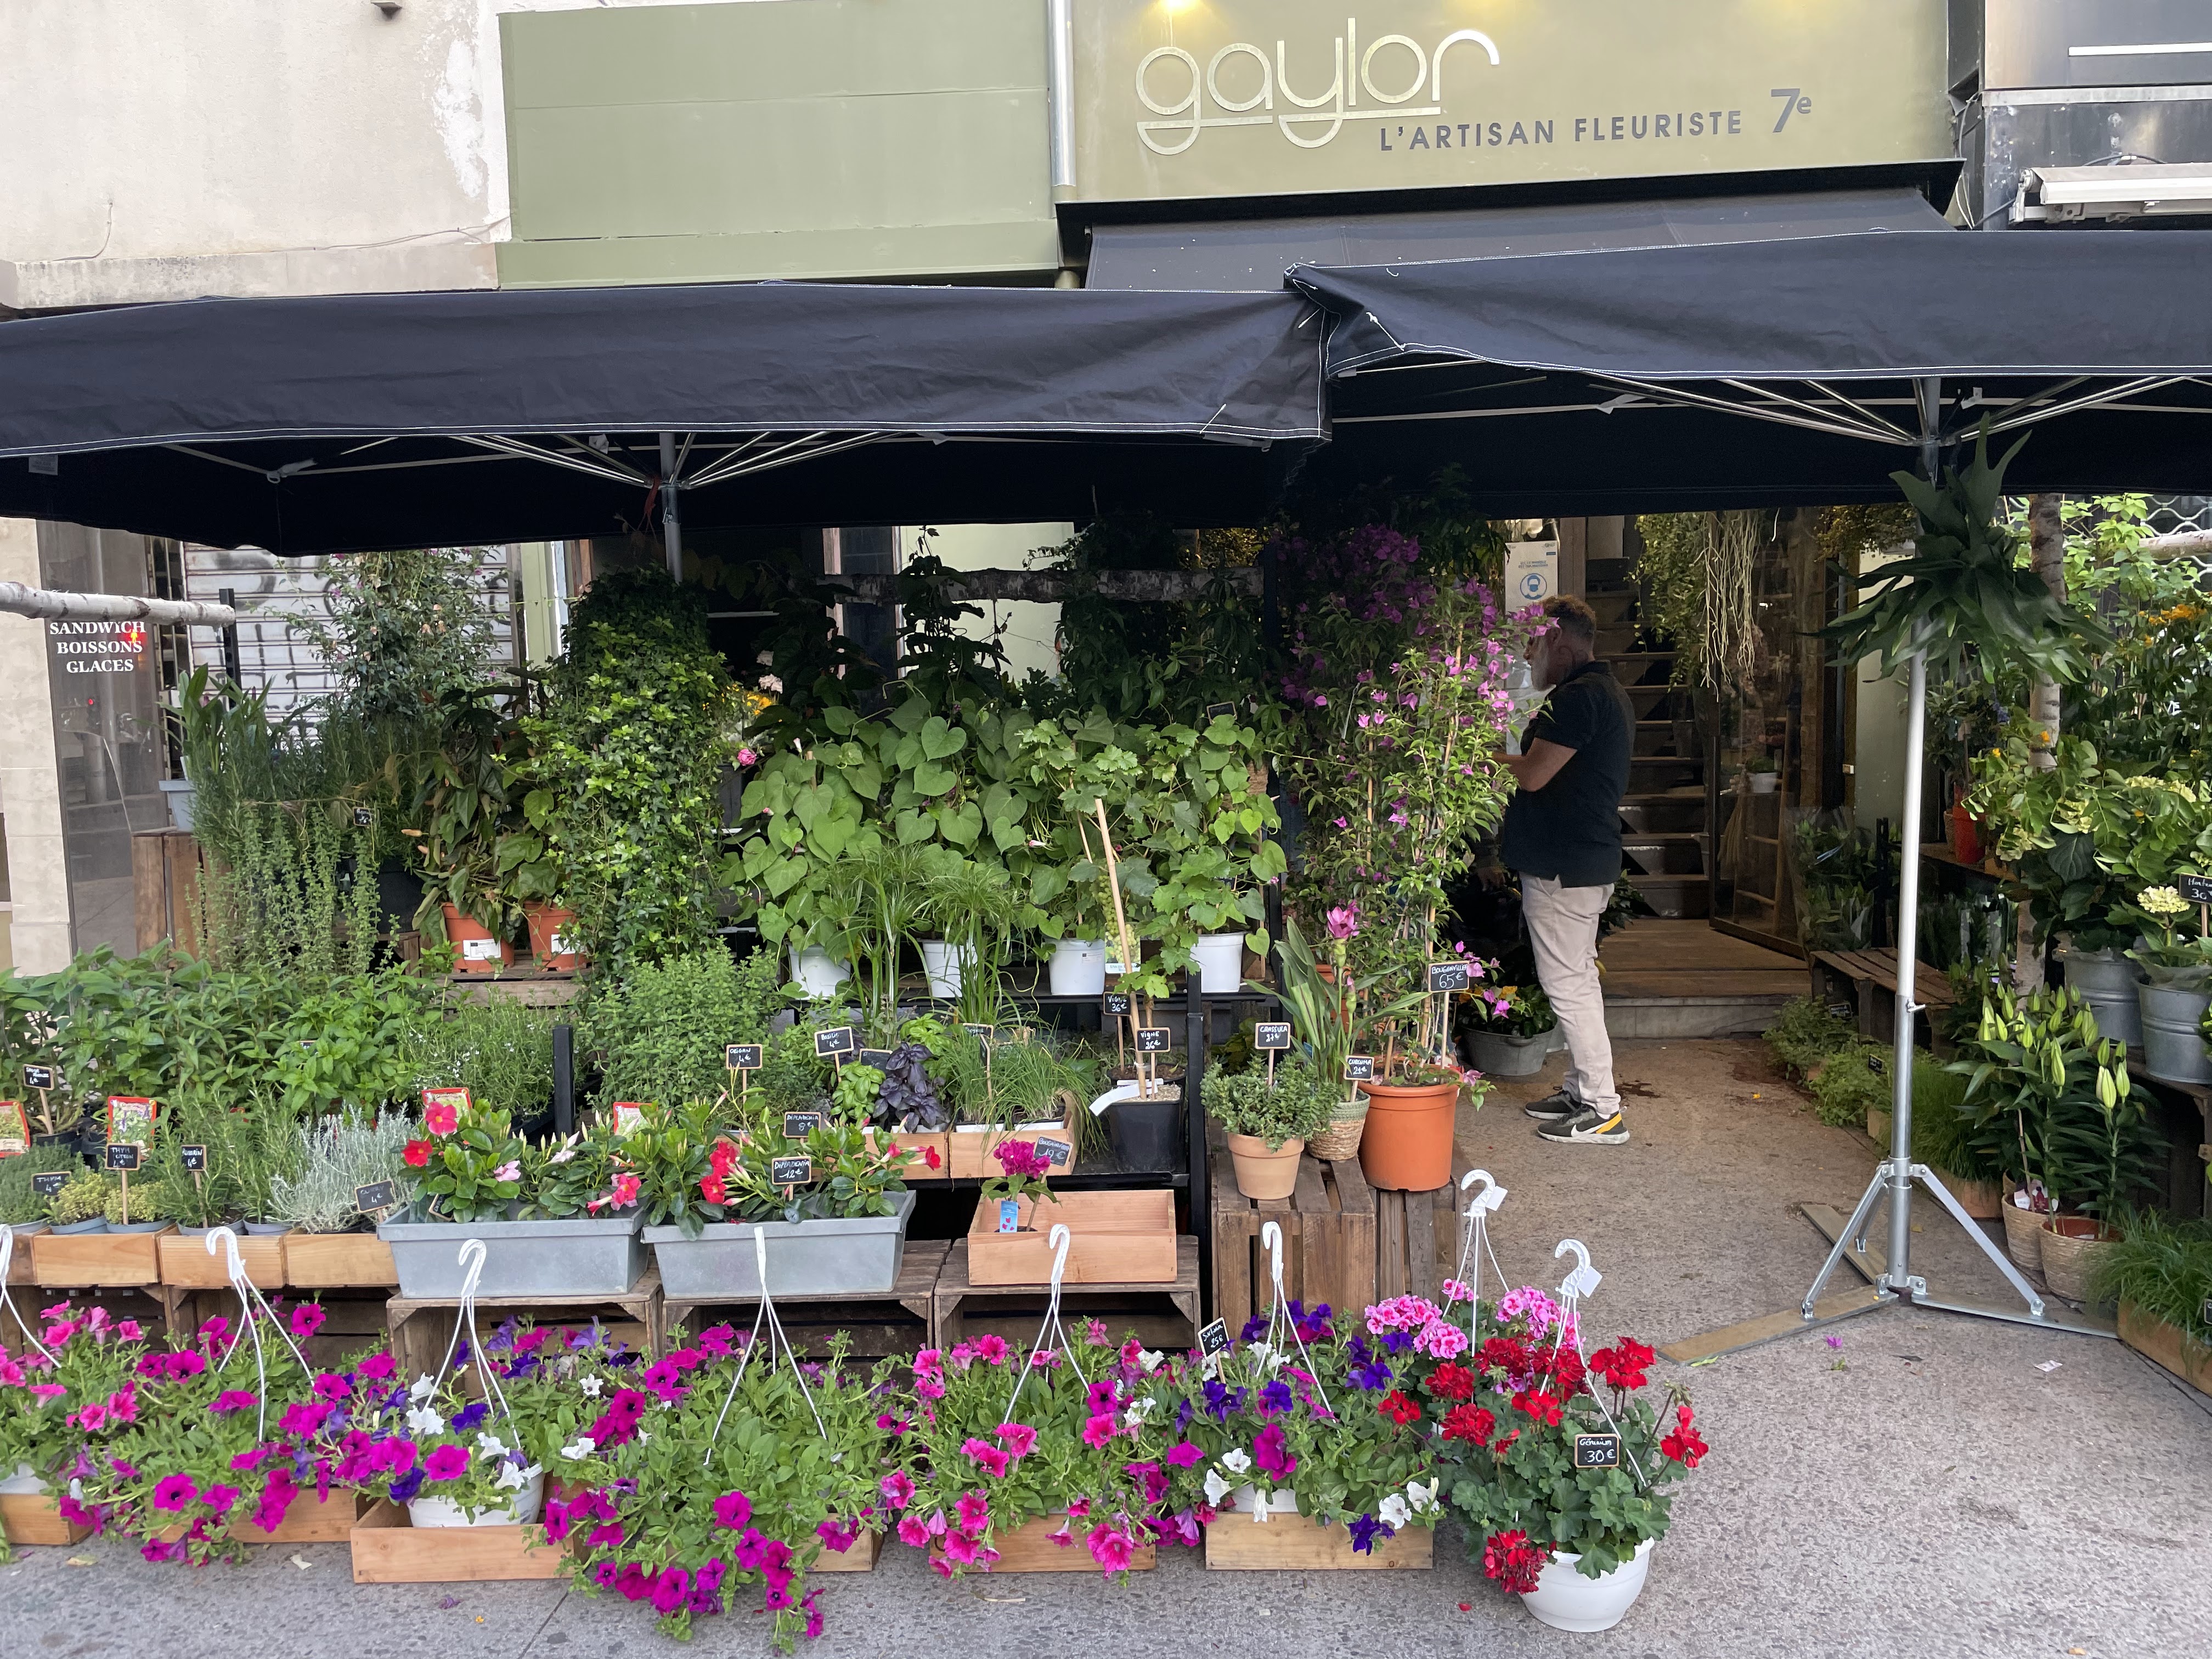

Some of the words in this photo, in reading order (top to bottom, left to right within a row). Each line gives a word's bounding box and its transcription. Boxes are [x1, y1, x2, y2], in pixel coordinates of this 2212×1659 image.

[1136, 18, 1499, 155] gaylor
[1380, 120, 1553, 151] L'ARTISAN
[1575, 110, 1741, 142] FLEURISTE
[49, 621, 147, 635] SANDWICH
[57, 641, 143, 654] BOISSONS
[66, 659, 134, 674] GLACES
[1587, 1448, 1616, 1463] 30€
